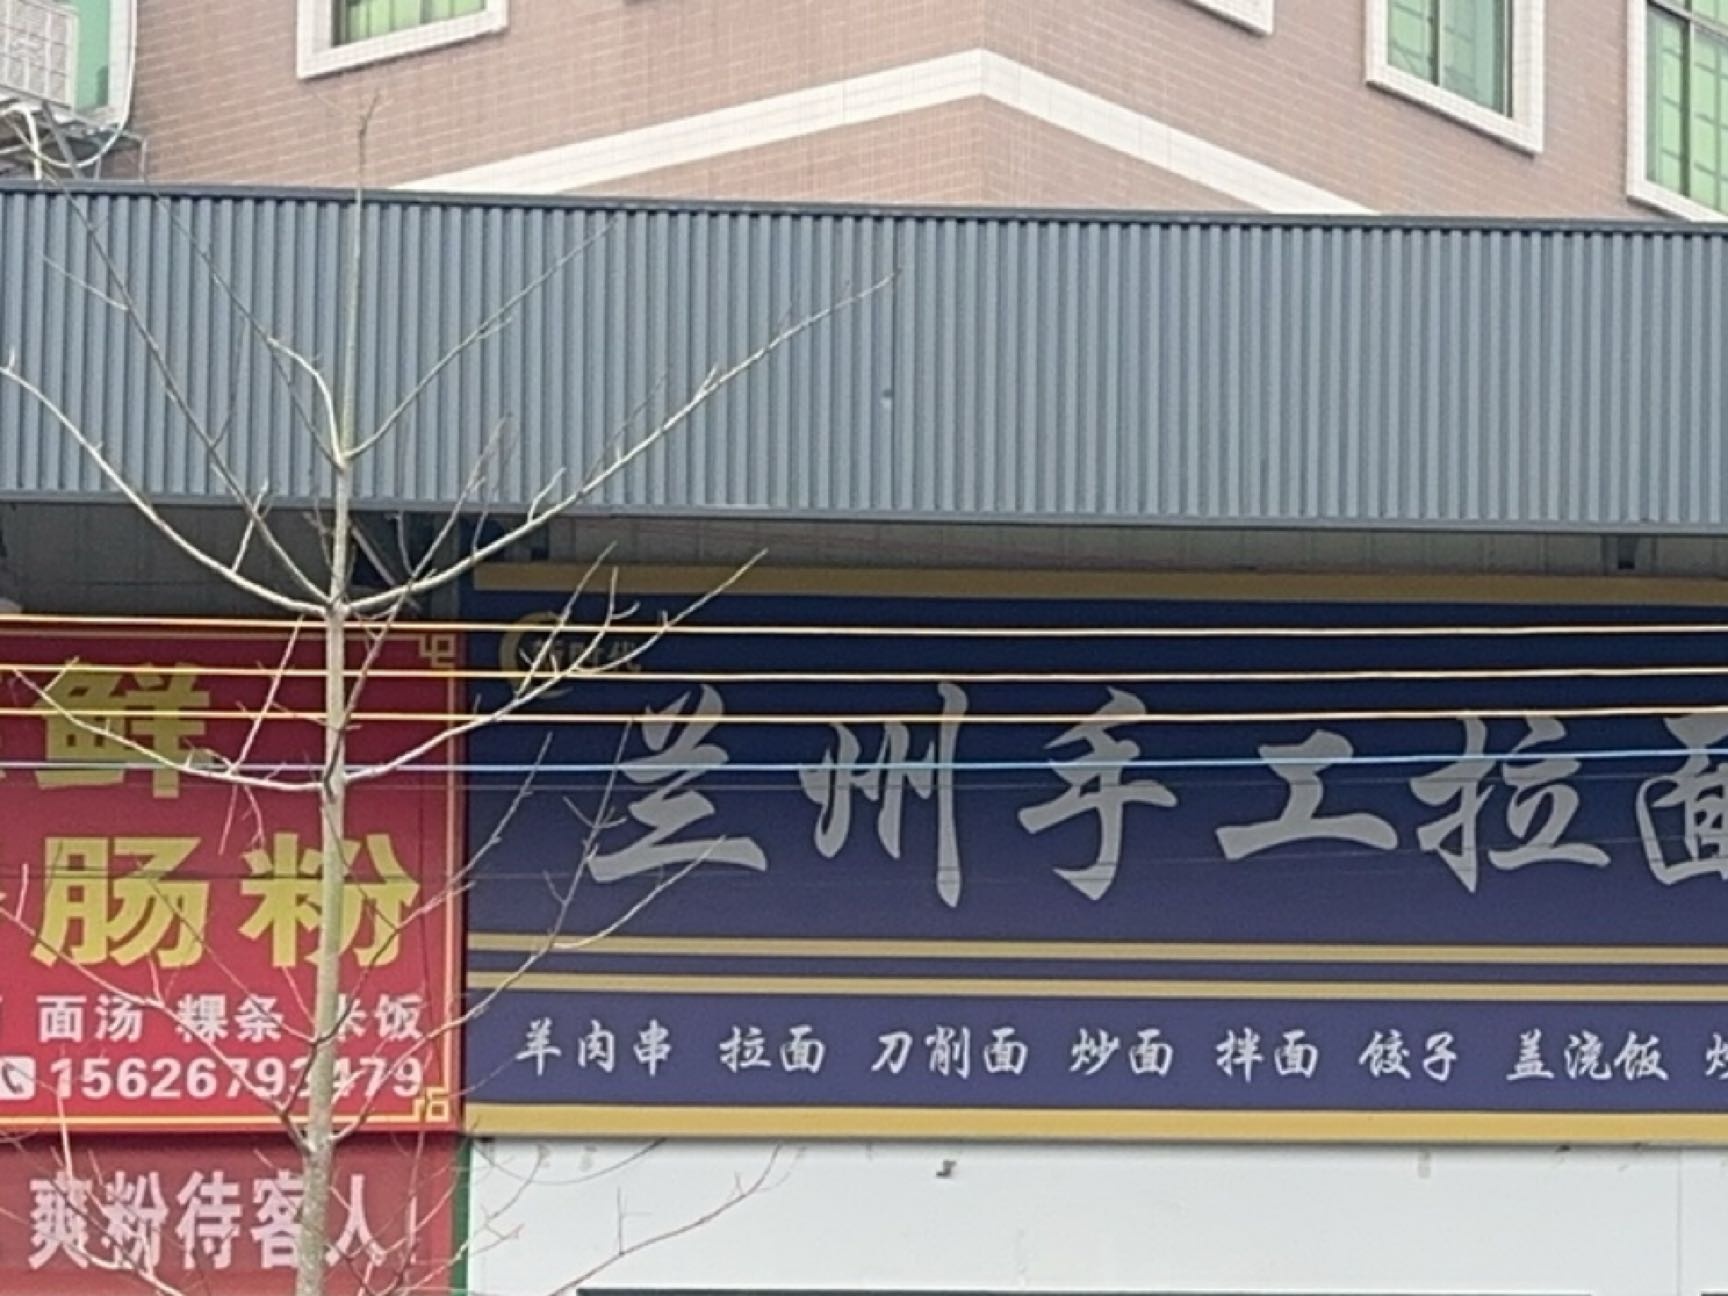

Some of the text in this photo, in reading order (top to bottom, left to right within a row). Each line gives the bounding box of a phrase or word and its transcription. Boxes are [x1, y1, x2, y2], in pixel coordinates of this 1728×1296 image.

[35, 661, 210, 798] 鲜
[31, 833, 420, 968] 肠粉
[37, 994, 148, 1043] 面汤
[515, 1019, 673, 1076] 羊肉串
[719, 1025, 826, 1075] 拉面
[871, 1026, 1029, 1080] 刀削面
[1069, 1027, 1175, 1077] 炒面
[1215, 1028, 1319, 1082] 拌面
[1358, 1031, 1460, 1082] 饺子
[1506, 1028, 1669, 1082] 盖浇饭
[27, 1170, 386, 1271] 爽粉待客人
